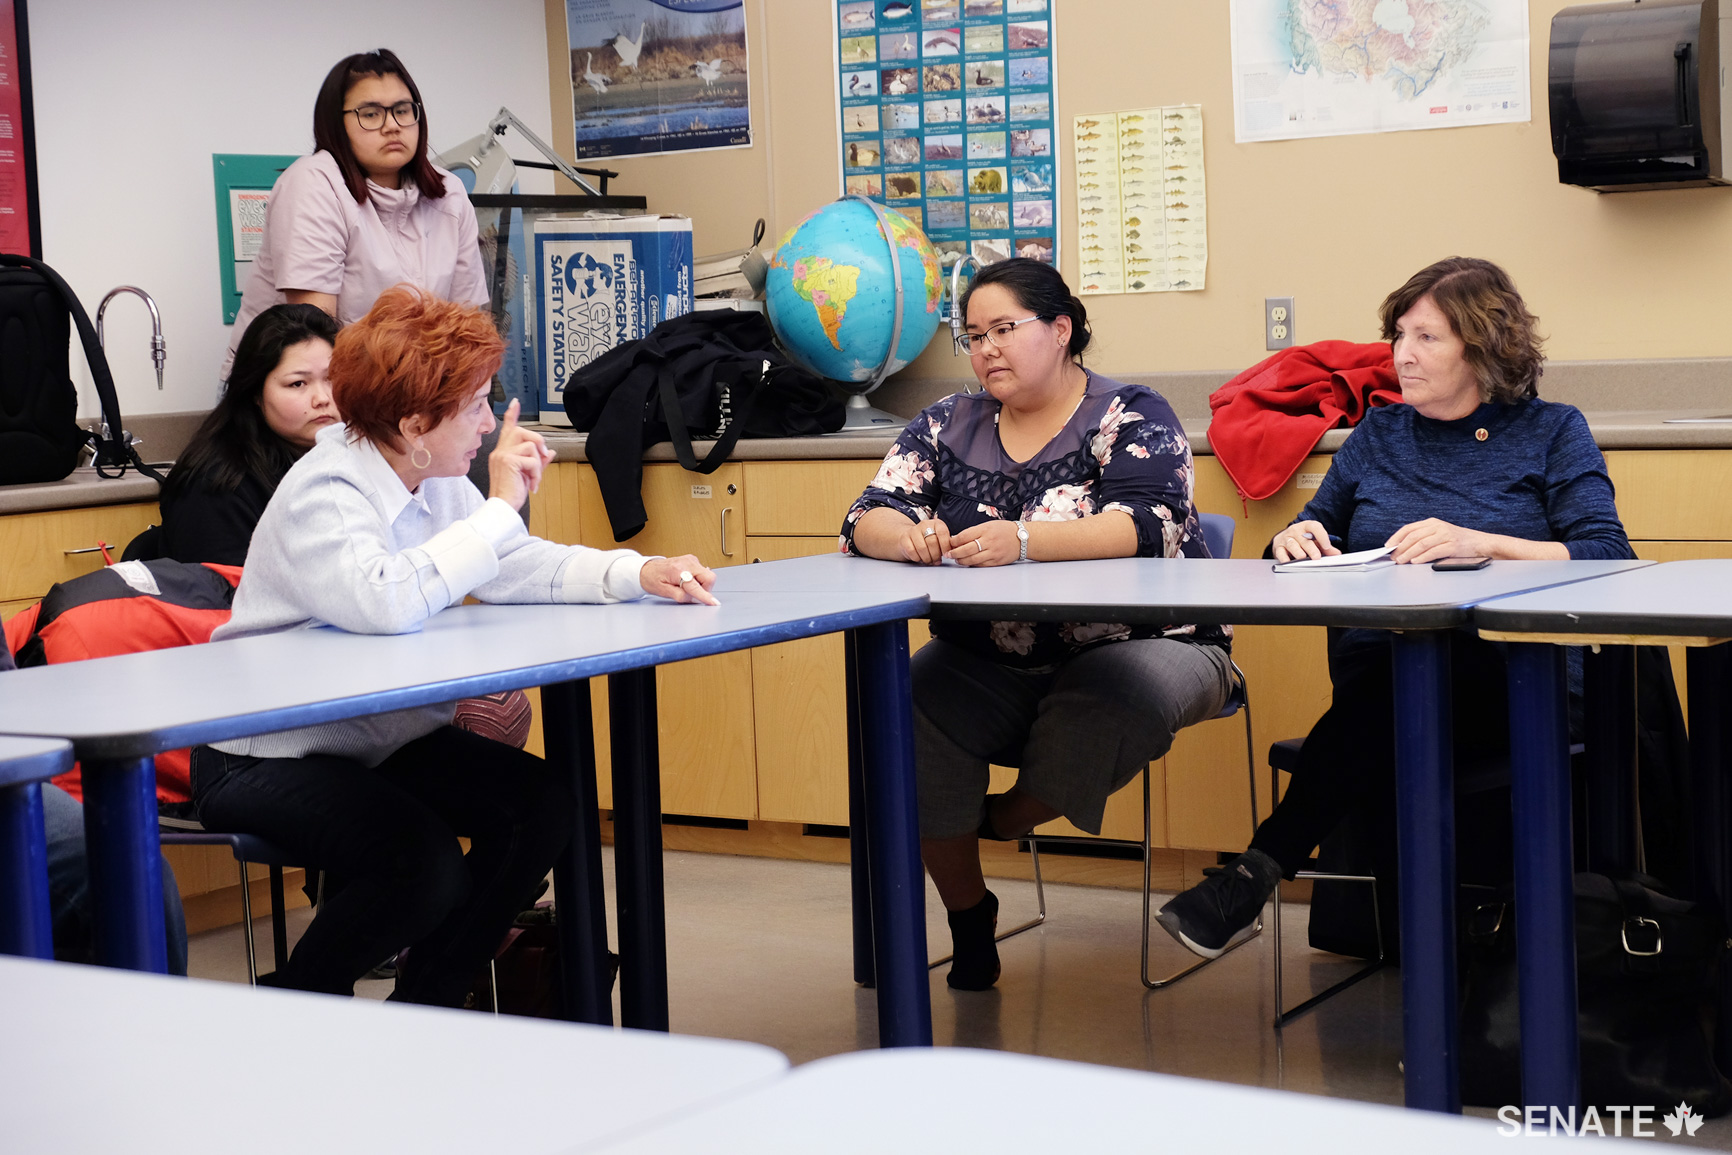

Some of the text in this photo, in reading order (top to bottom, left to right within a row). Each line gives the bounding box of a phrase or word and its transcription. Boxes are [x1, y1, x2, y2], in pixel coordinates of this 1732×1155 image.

[239, 213, 266, 228] was
[550, 254, 566, 392] SAFETY STATION
[613, 253, 627, 346] EMERGENC
[639, 300, 647, 326] quality
[568, 303, 591, 375] was
[520, 347, 530, 394] PERCH
